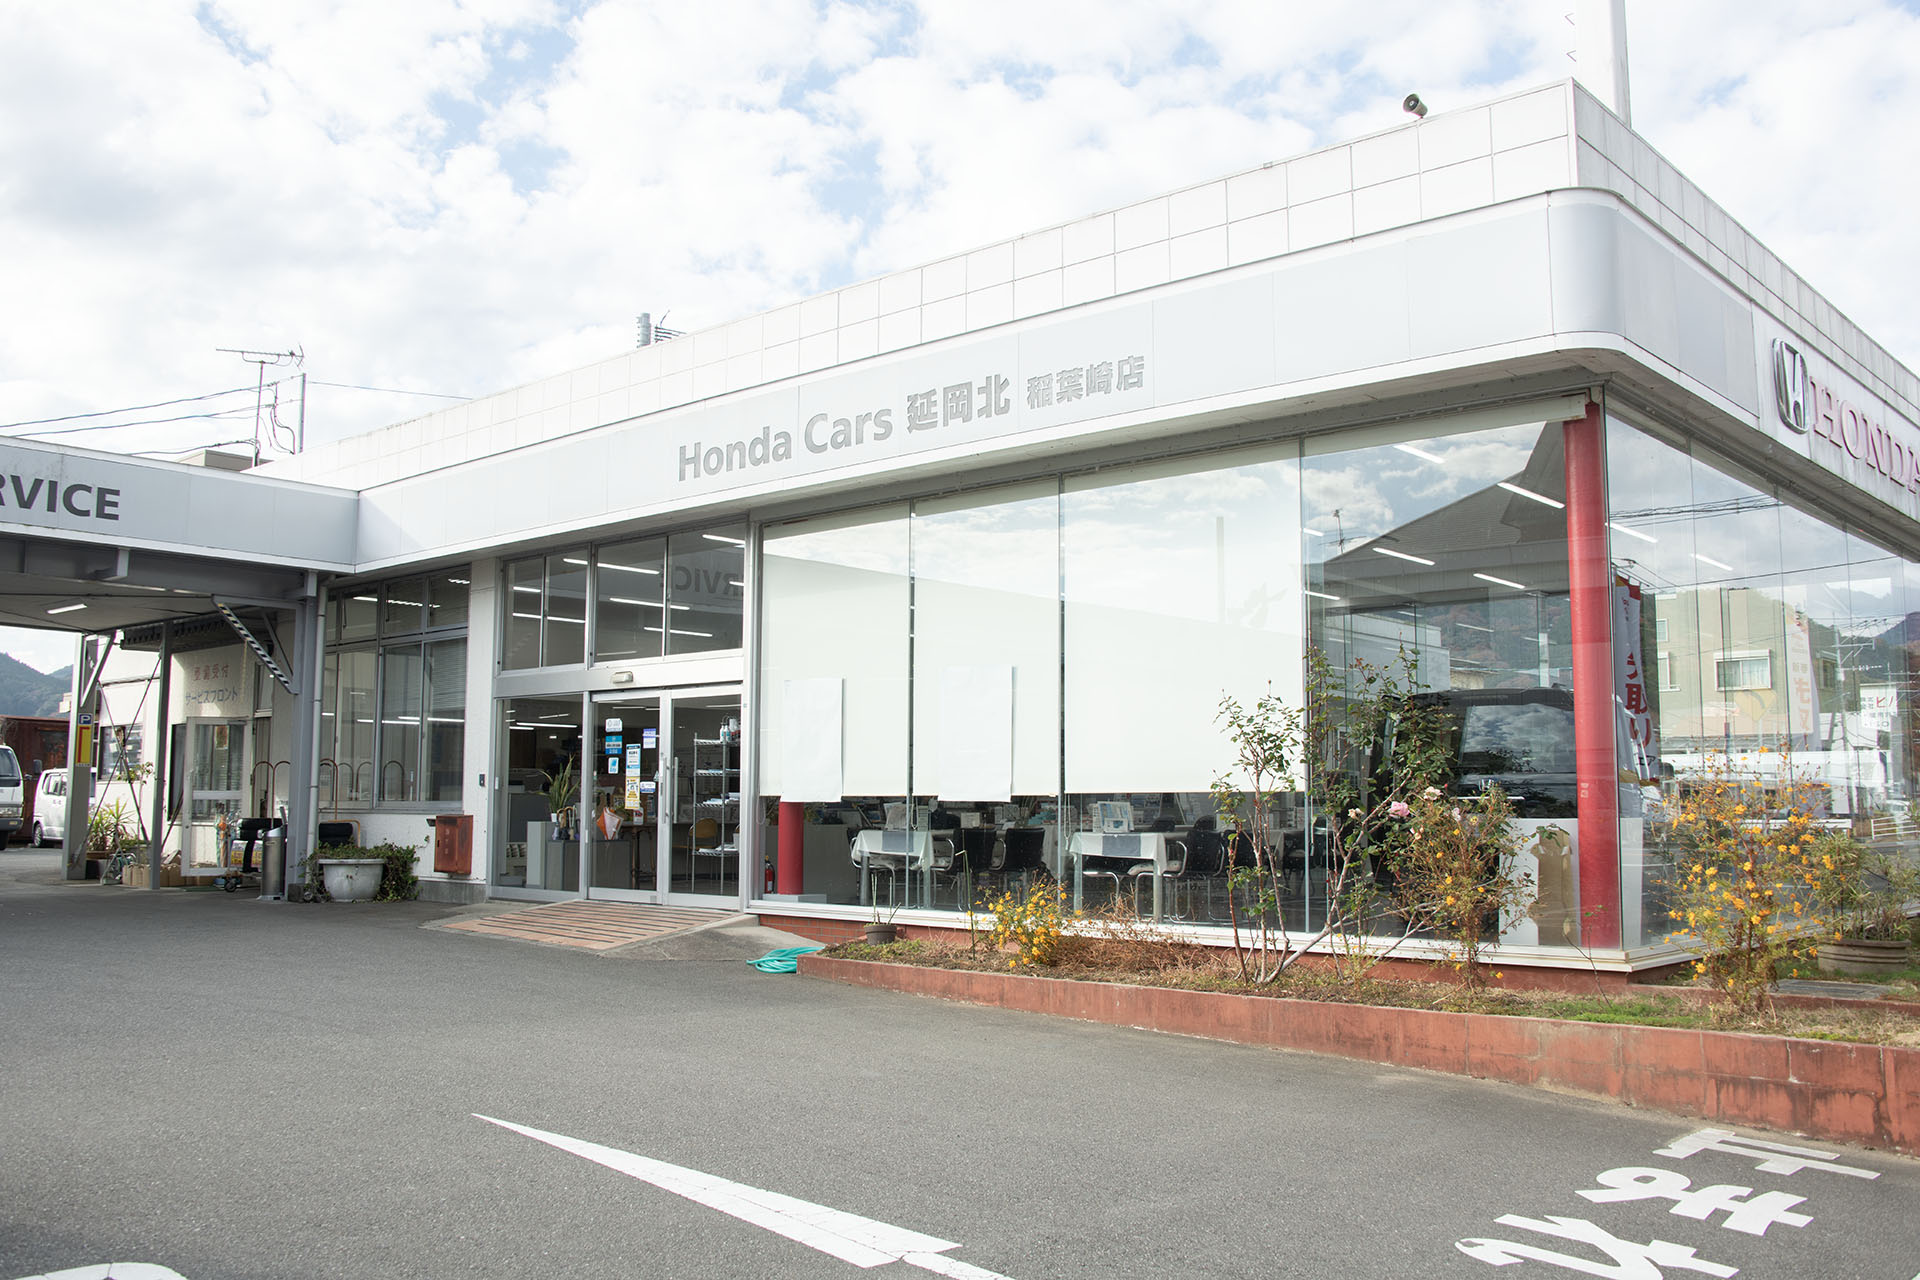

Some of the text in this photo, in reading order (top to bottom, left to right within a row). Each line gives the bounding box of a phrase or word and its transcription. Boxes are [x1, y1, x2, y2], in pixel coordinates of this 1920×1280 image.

[679, 356, 1144, 480] Honda Cars 延岡北 稲葉崎店
[0, 475, 120, 520] VICE
[185, 686, 238, 706] サービスフロント
[81, 715, 91, 724] P
[1454, 1128, 1881, 1280] 止まれ
